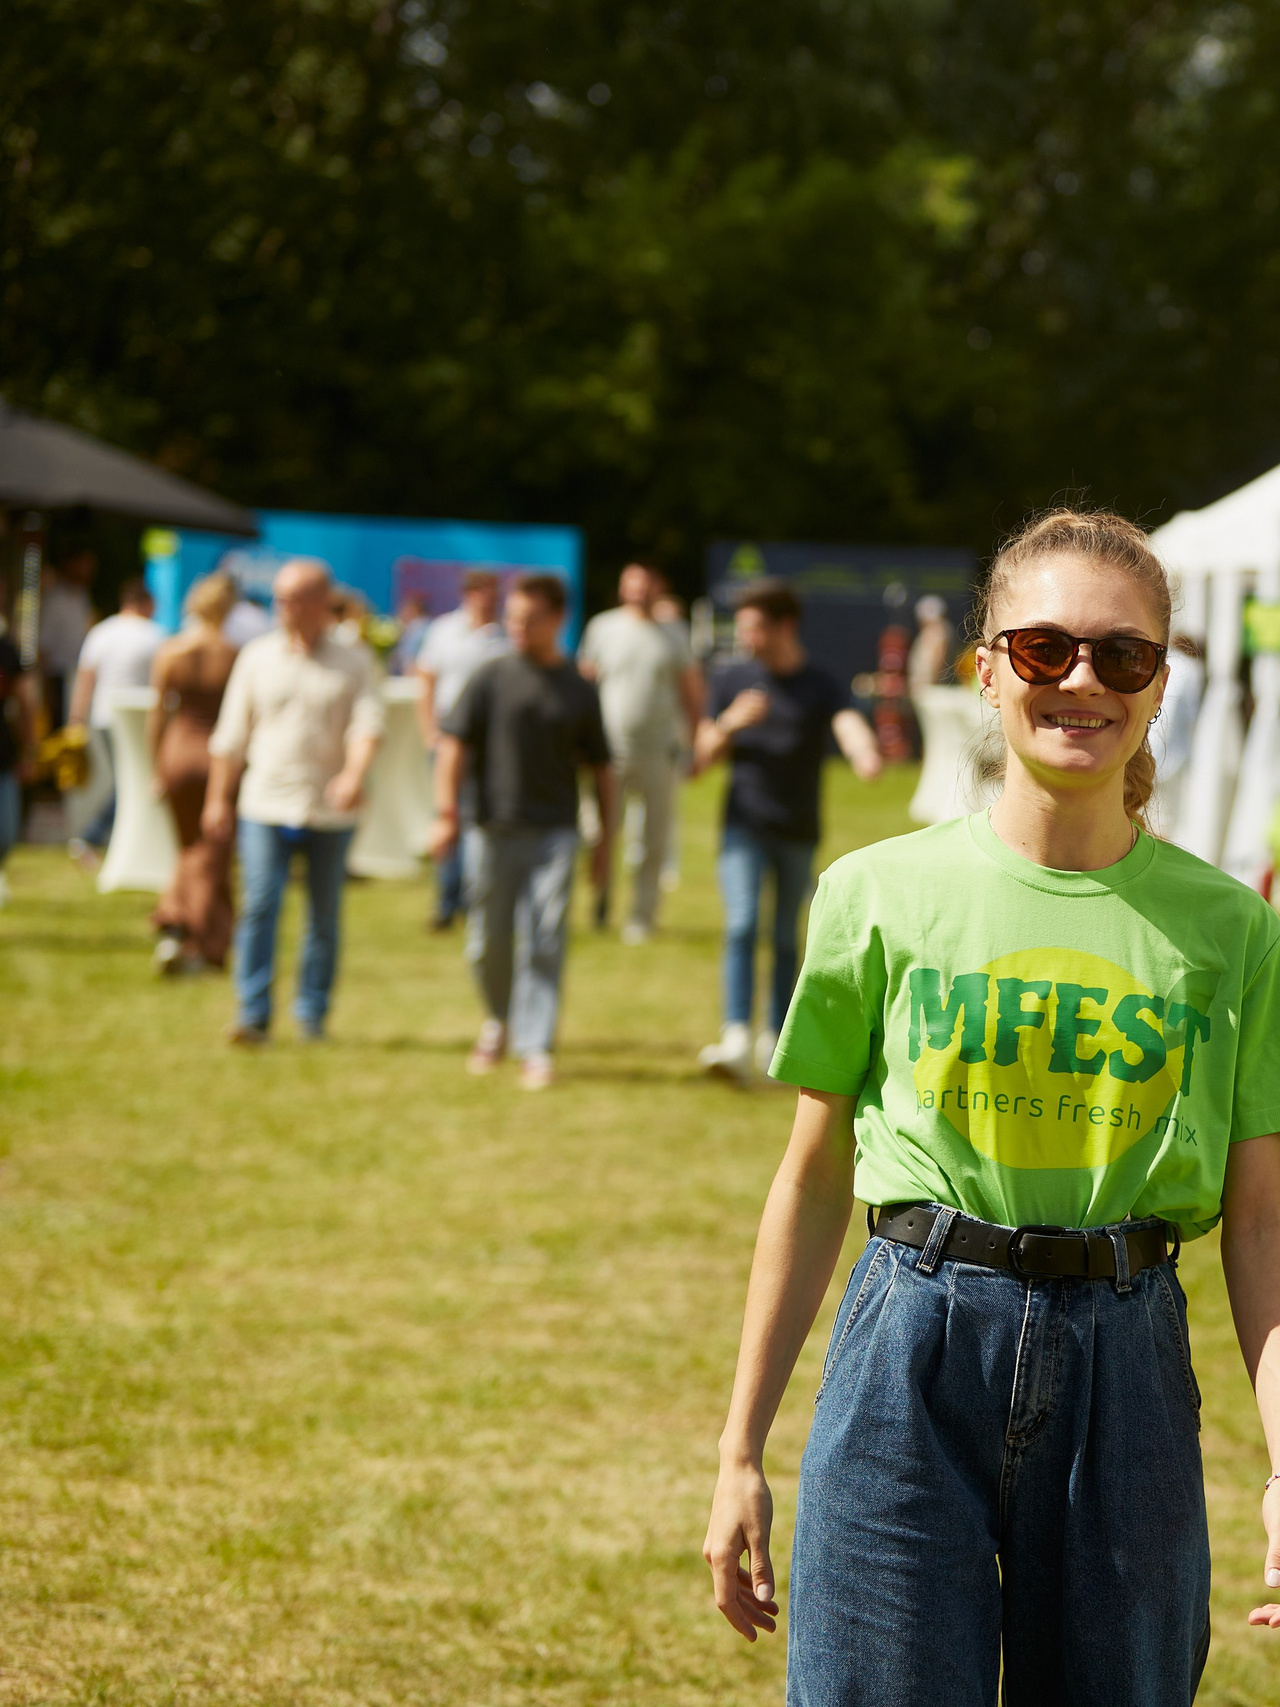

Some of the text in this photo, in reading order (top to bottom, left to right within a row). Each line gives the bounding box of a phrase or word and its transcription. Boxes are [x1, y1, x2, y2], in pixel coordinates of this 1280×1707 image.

[907, 967, 1211, 1097] MFEST
[1057, 1094, 1141, 1130] fresh
[1153, 1115, 1198, 1147] mix
